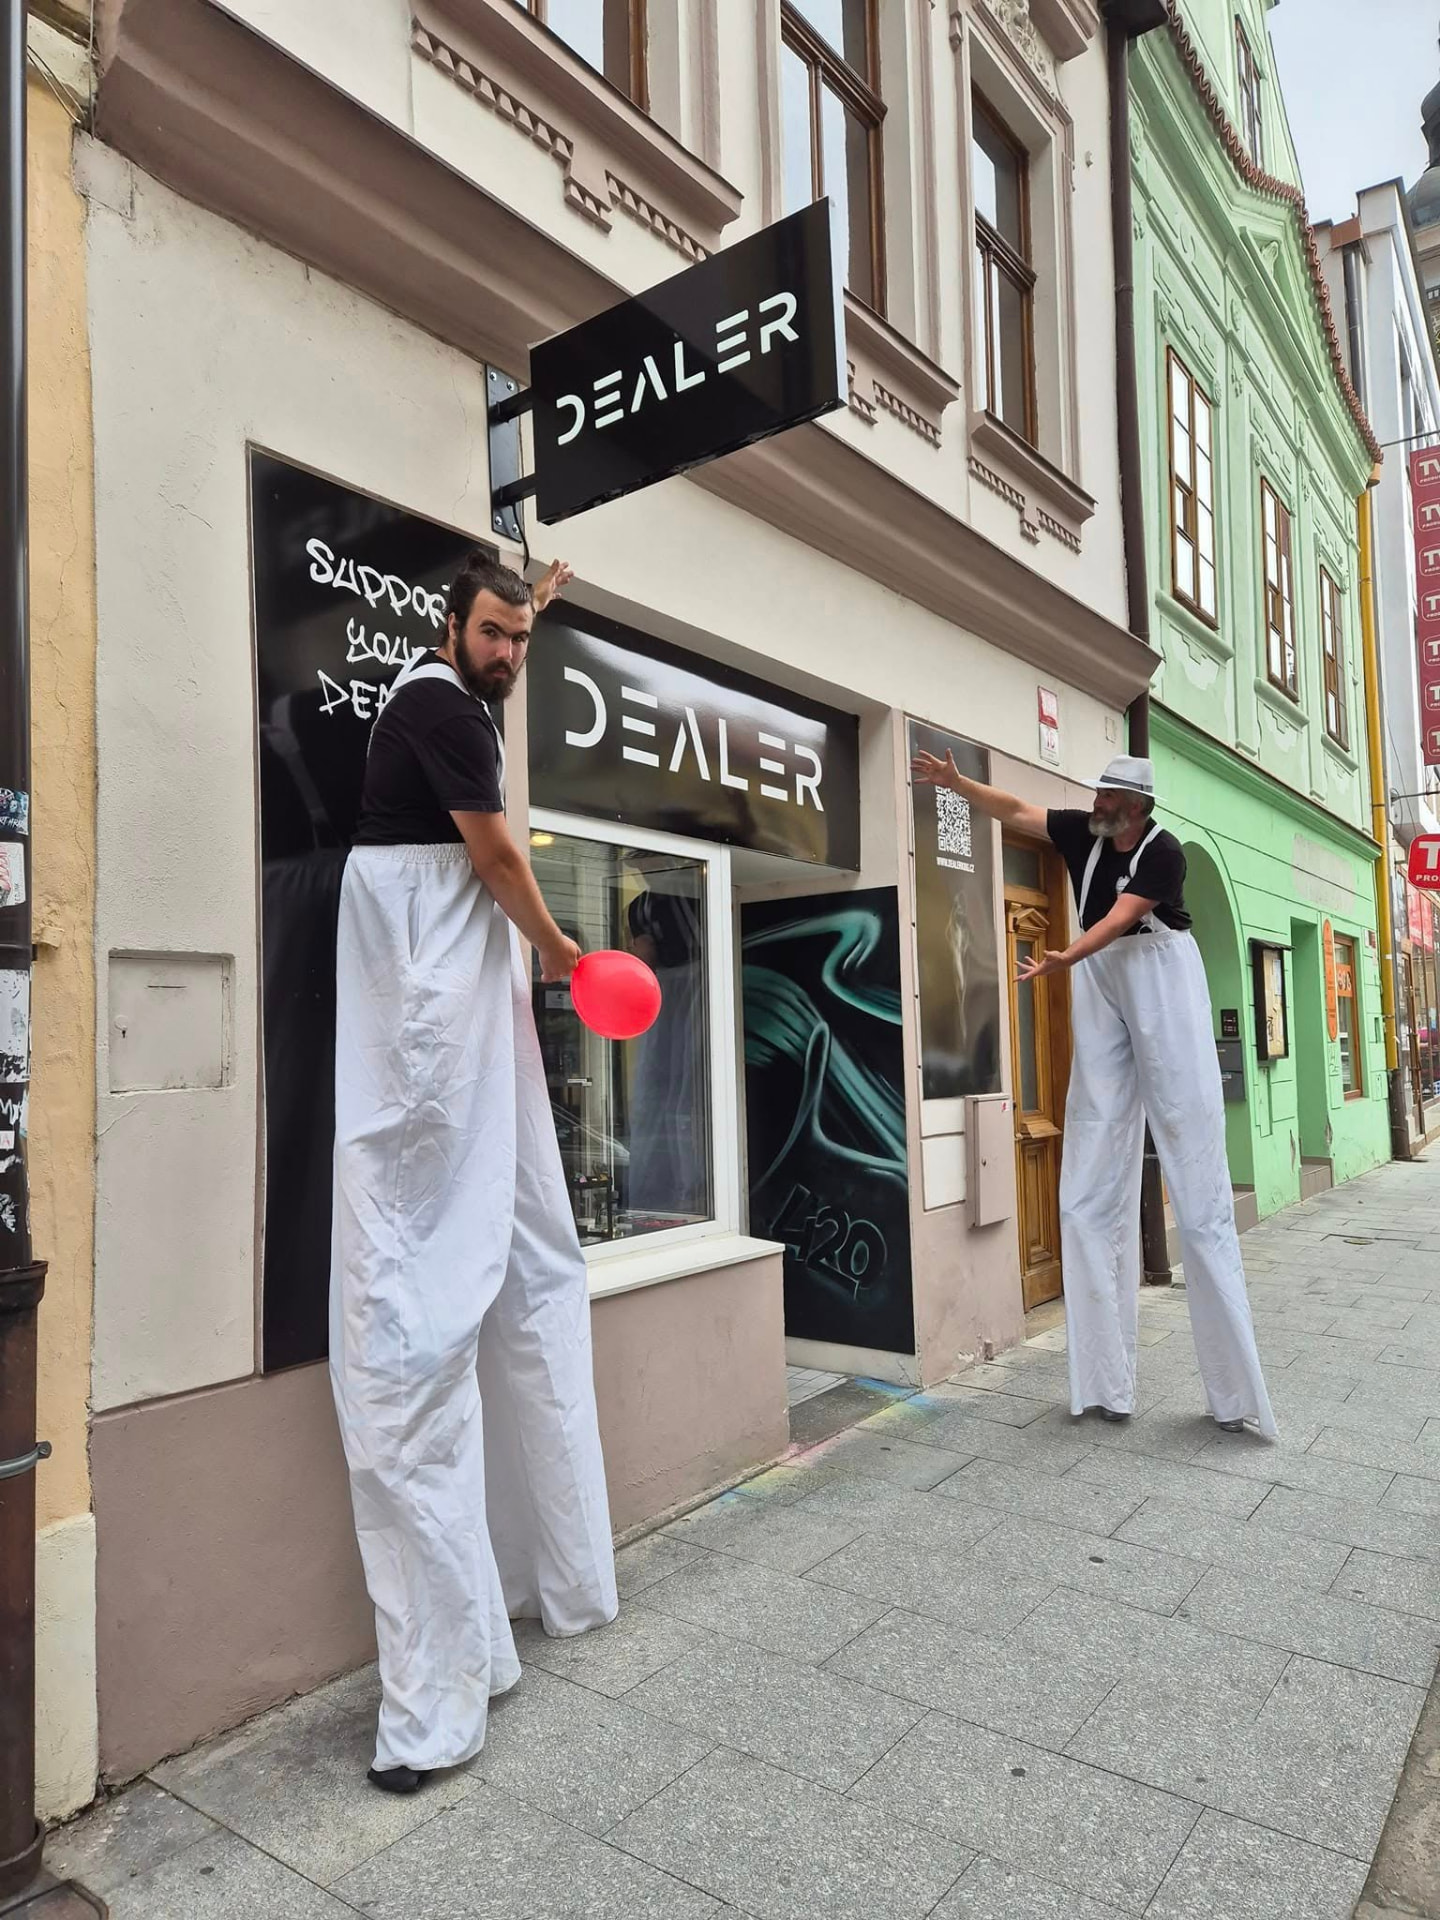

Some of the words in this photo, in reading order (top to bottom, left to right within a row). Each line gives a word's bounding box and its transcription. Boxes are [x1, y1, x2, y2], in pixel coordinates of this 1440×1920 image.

[556, 292, 799, 446] DEALER
[306, 537, 450, 628] SUPPOR
[564, 666, 825, 812] DEALER
[1416, 874, 1440, 882] PRO
[769, 1183, 888, 1301] 420
